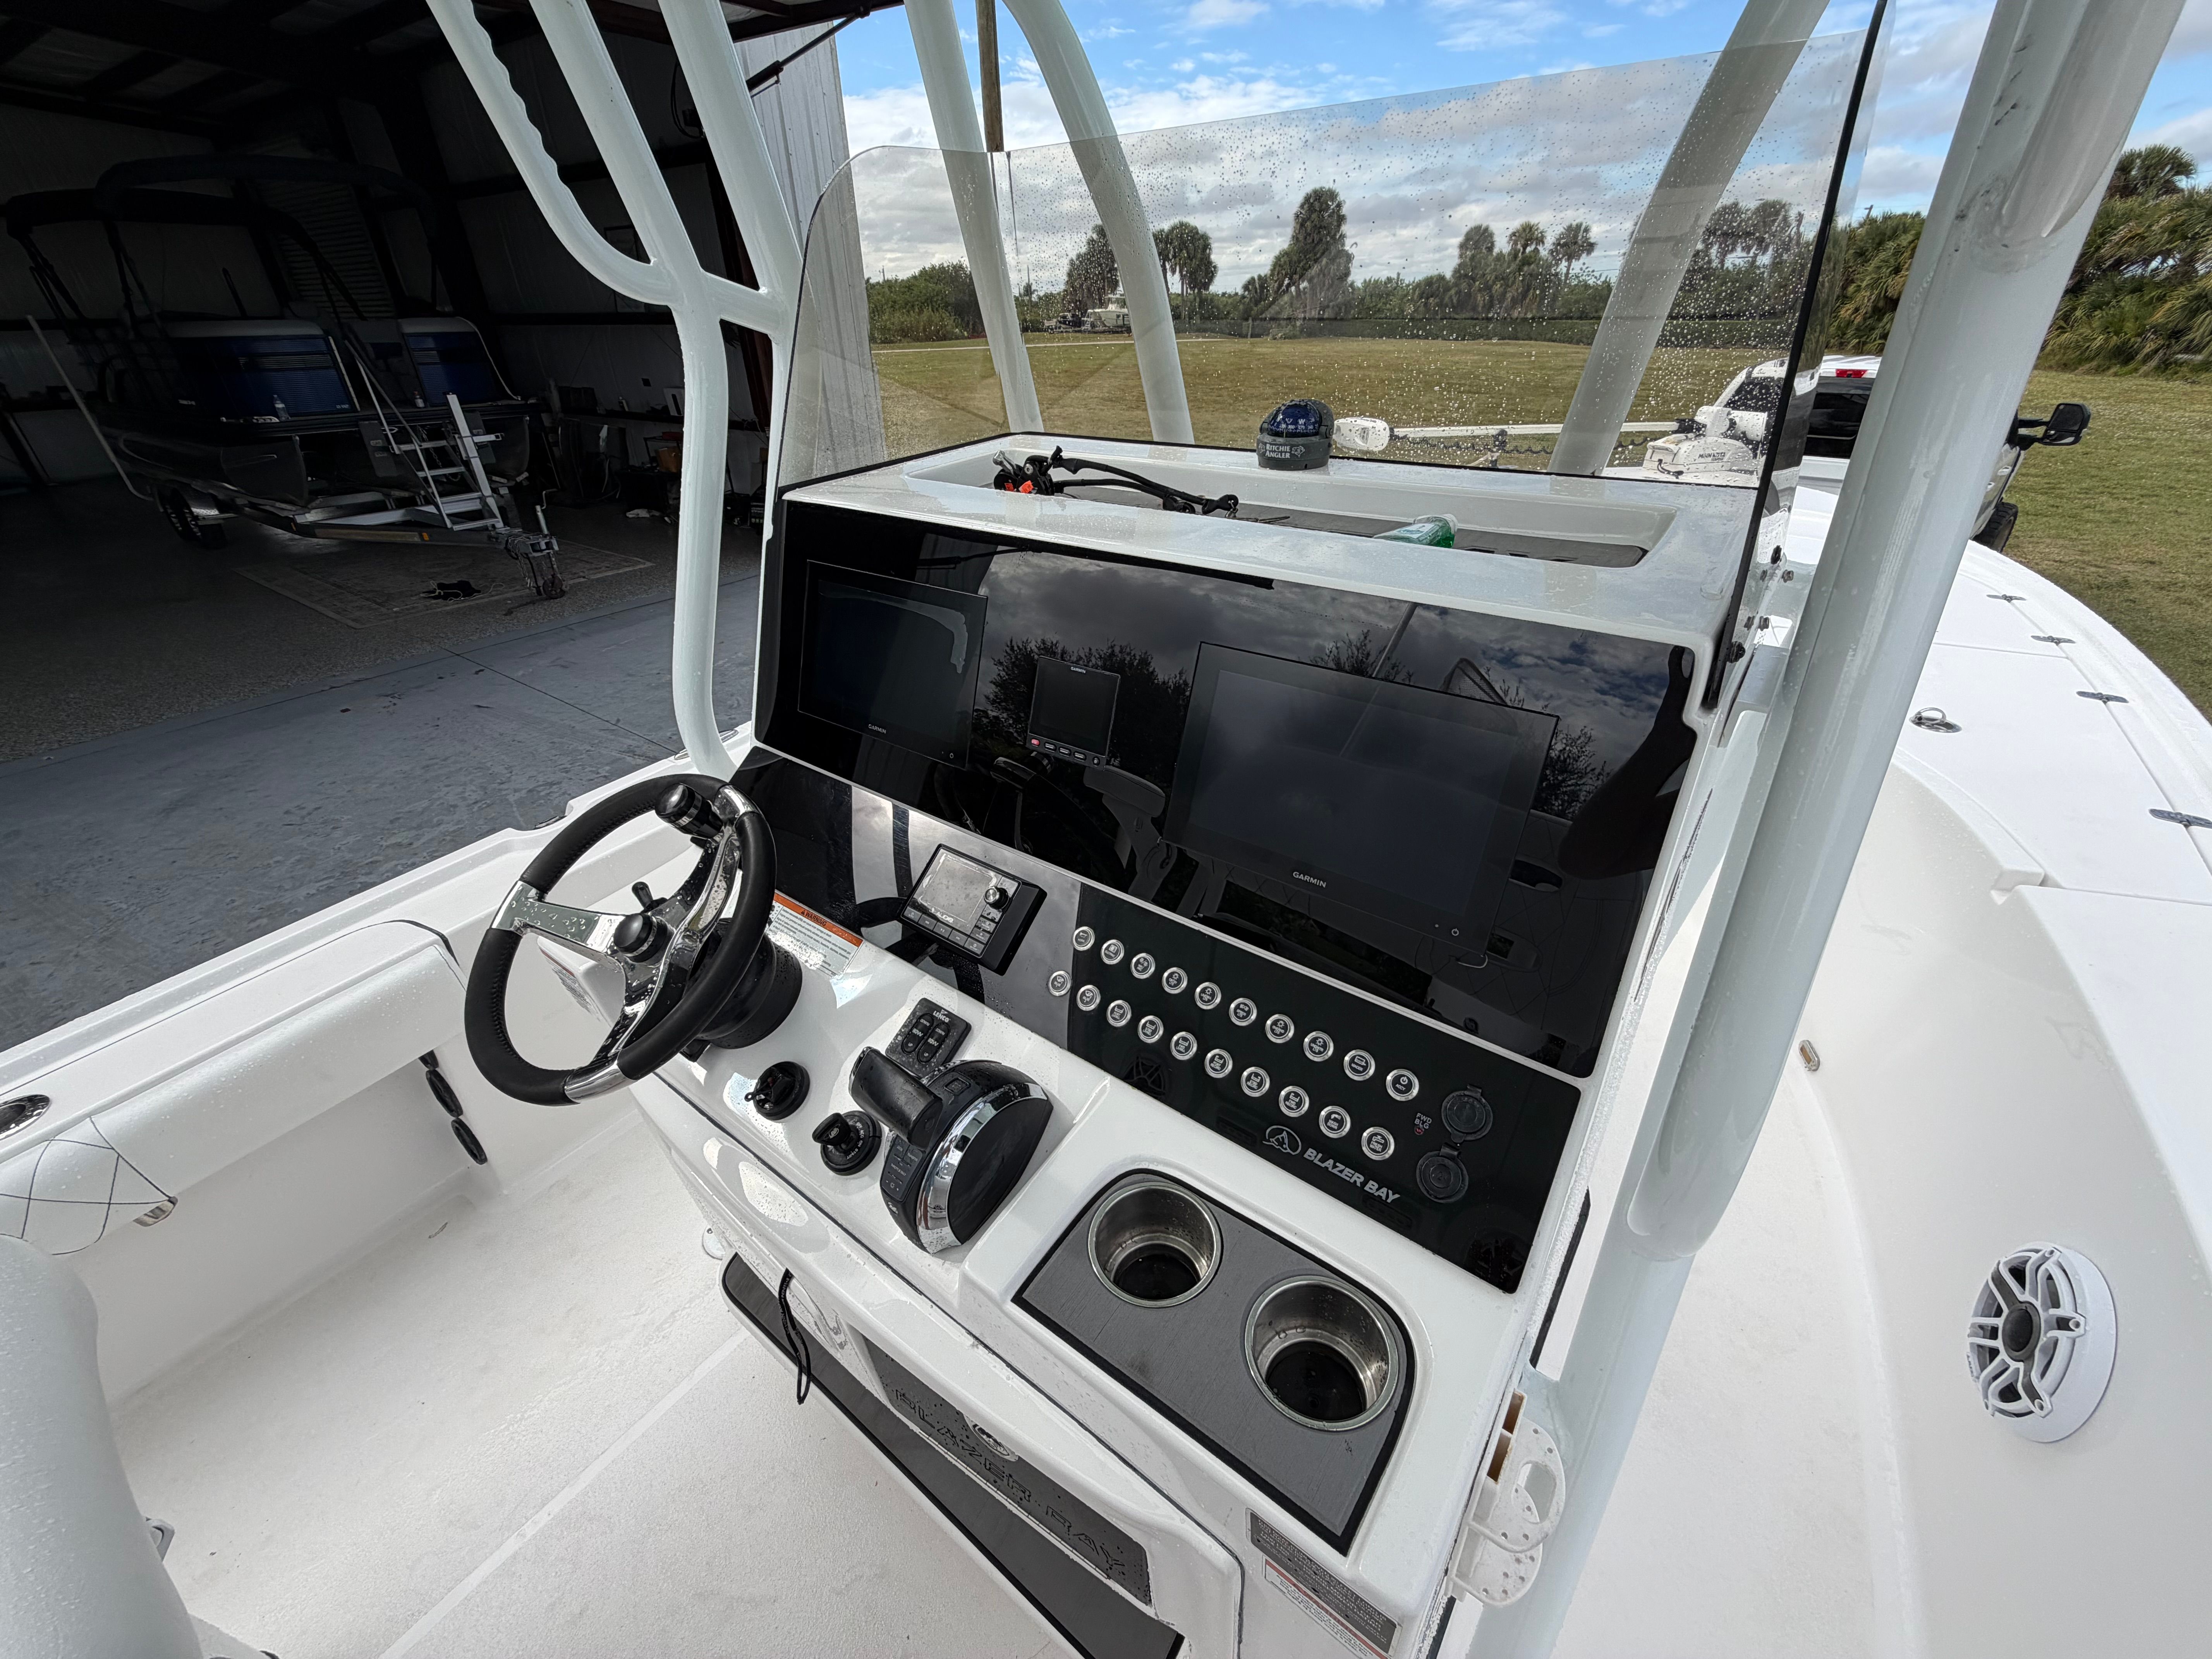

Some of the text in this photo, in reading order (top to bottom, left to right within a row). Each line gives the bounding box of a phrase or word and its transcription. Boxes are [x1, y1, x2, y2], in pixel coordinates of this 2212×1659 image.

[1266, 443, 1291, 452] RITCHIE
[1265, 450, 1290, 459] ANGLER
[868, 724, 886, 734] GARMIN
[1293, 871, 1326, 888] GARMIN
[805, 911, 827, 927] WARNING
[933, 1010, 950, 1023] LENCO
[912, 1028, 924, 1037] BOW
[927, 1037, 939, 1046] BOW
[1416, 1113, 1432, 1123] FWD
[1414, 1118, 1429, 1129] BLG
[1303, 1148, 1401, 1203] BLAZER BAY
[895, 1389, 1125, 1567] BLAZER BAY
